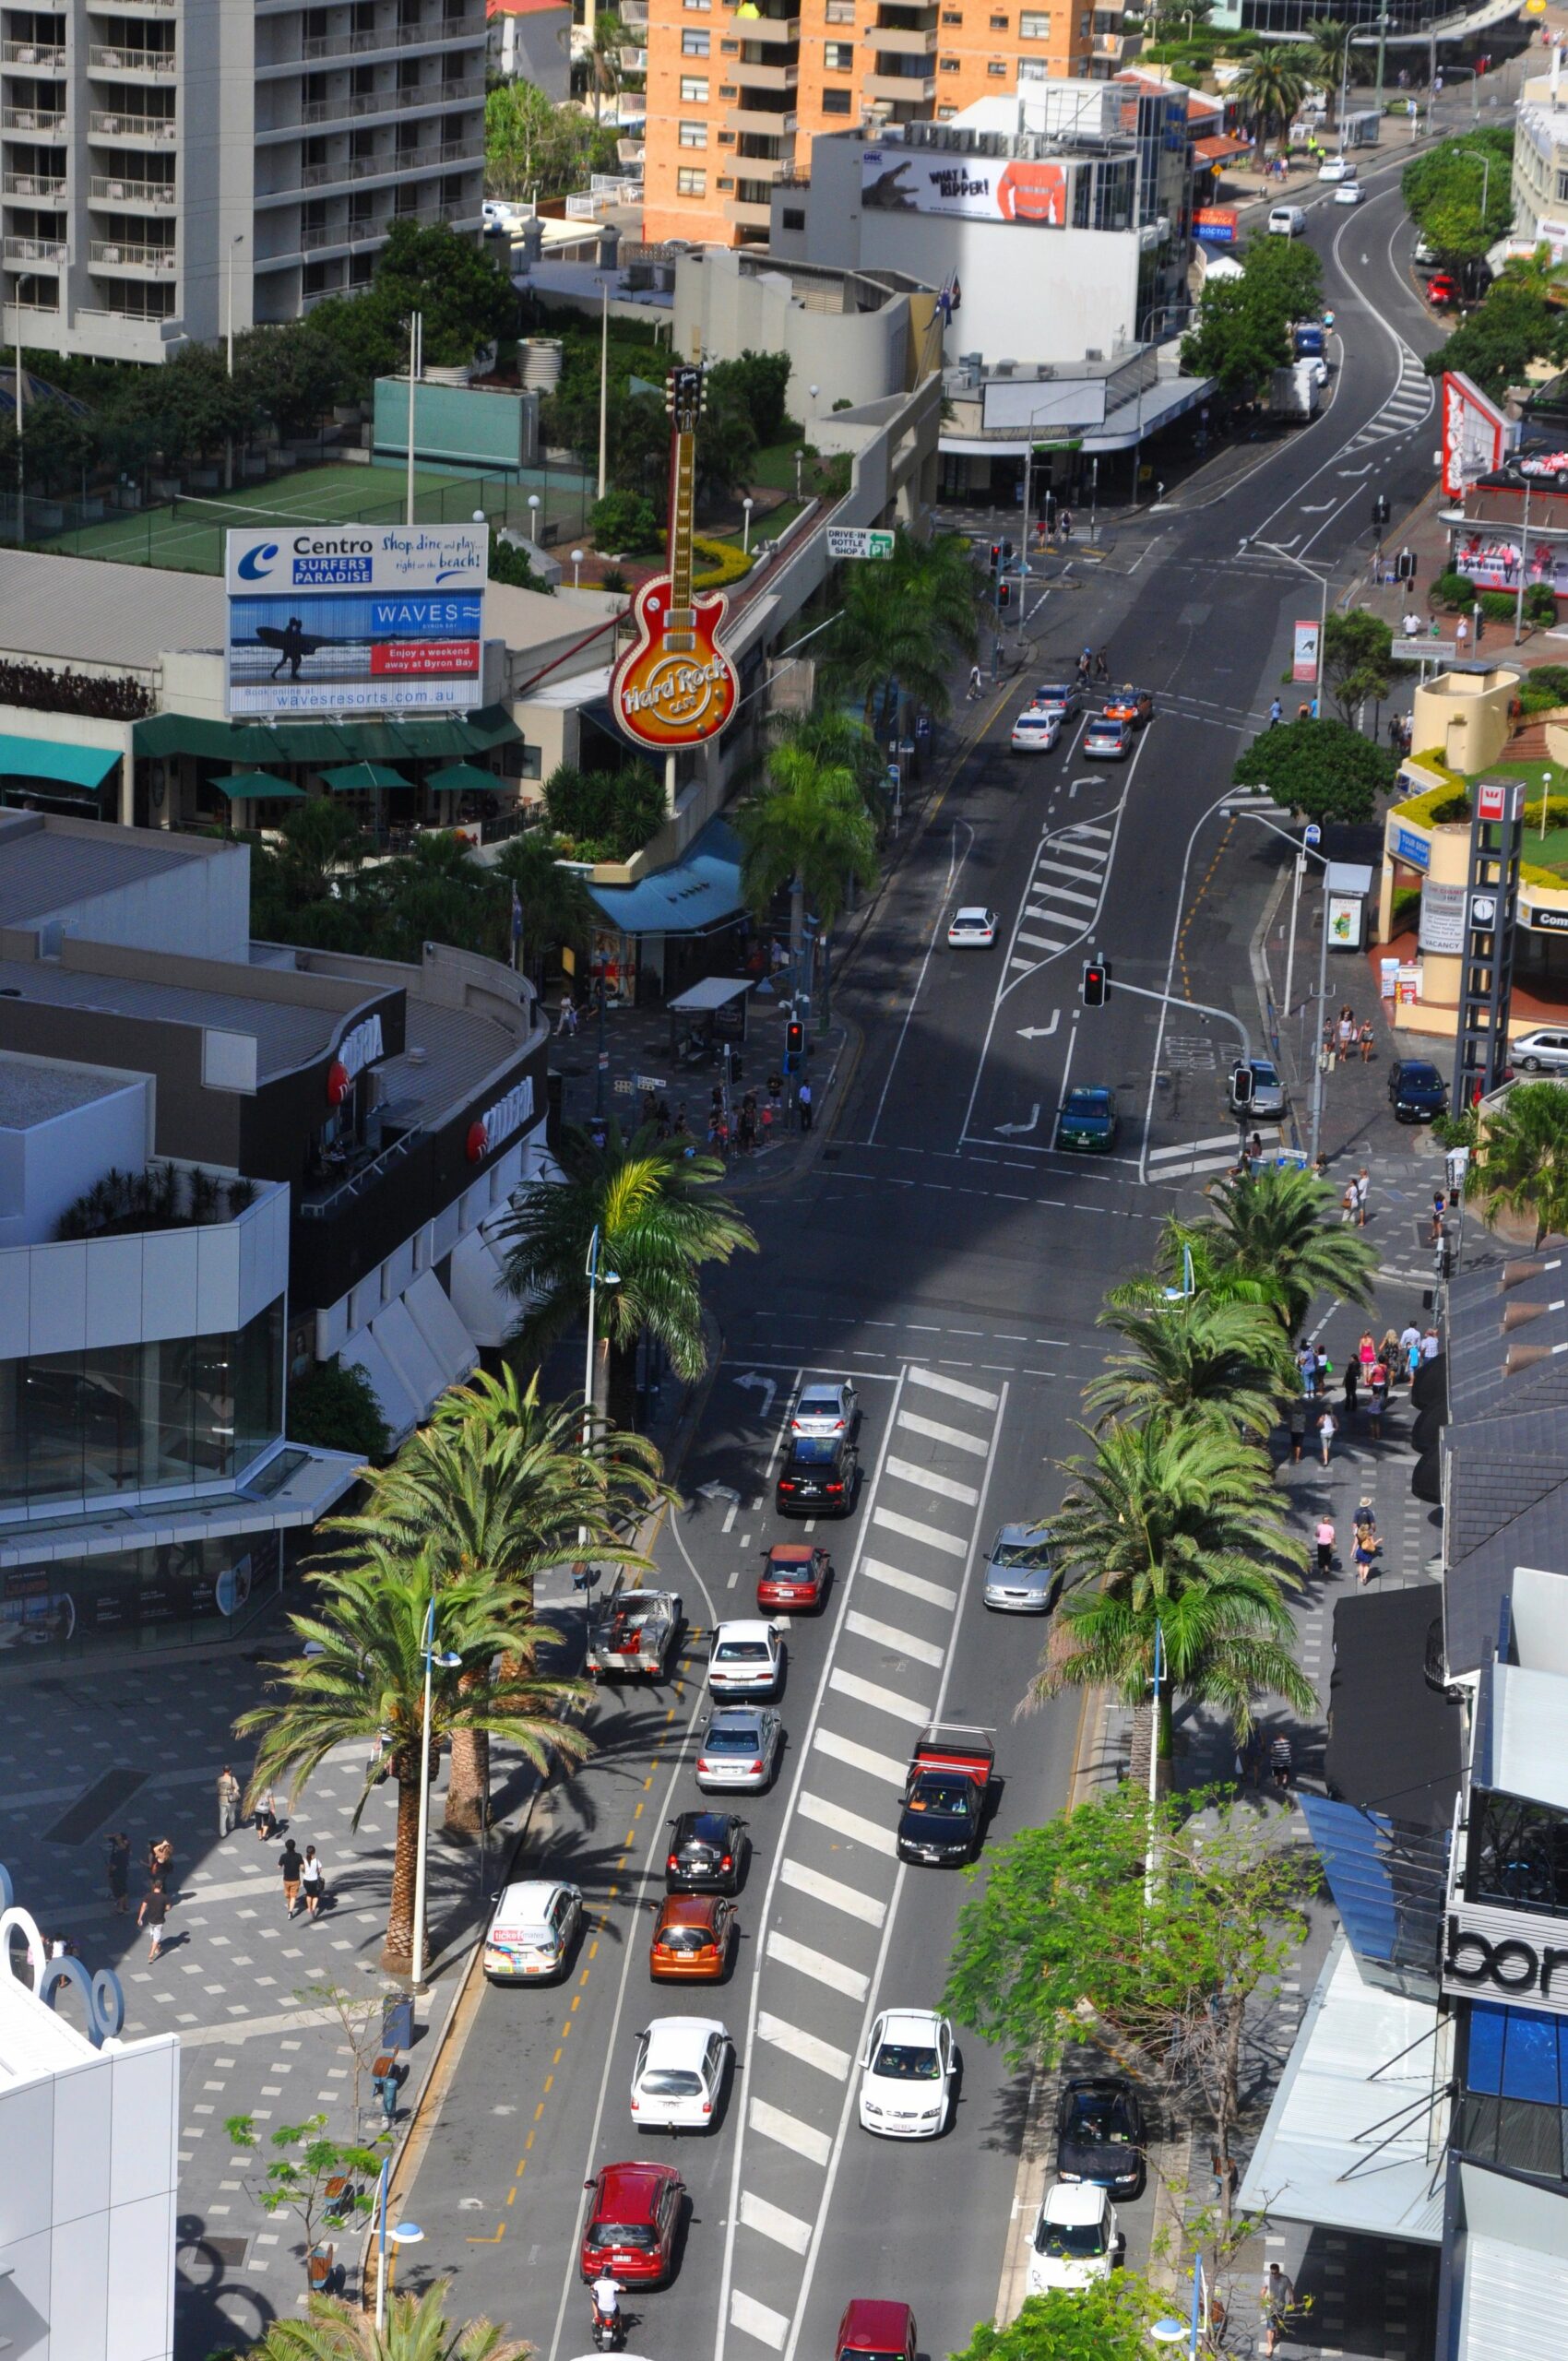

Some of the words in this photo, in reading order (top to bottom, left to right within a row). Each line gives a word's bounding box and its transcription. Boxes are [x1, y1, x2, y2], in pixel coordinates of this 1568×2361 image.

[929, 169, 958, 184] WHAT
[961, 168, 968, 180] A
[940, 179, 989, 197] RIPPER!
[828, 530, 866, 539] DRIVE-IN
[293, 537, 373, 554] Centro
[416, 533, 441, 551] dine
[444, 540, 455, 549] and
[835, 547, 857, 555] SHOP
[299, 559, 366, 571] SURFERS
[396, 557, 416, 573] right
[426, 559, 436, 568] the
[439, 554, 480, 568] beach!
[295, 571, 370, 583] PARADISE
[377, 604, 457, 622] WAVES
[389, 648, 417, 658] Enjoy
[427, 647, 469, 657] weekend
[385, 660, 410, 669] away
[424, 658, 453, 669] Byron
[456, 658, 473, 668] Bay
[623, 672, 674, 714] Hard
[676, 653, 729, 694] Rock
[245, 688, 270, 696] Book
[273, 687, 303, 695] online
[277, 691, 454, 707] wavesresorts.com.au
[670, 695, 696, 714] CAFE
[920, 718, 928, 728] P
[1425, 939, 1460, 949] VACANCY
